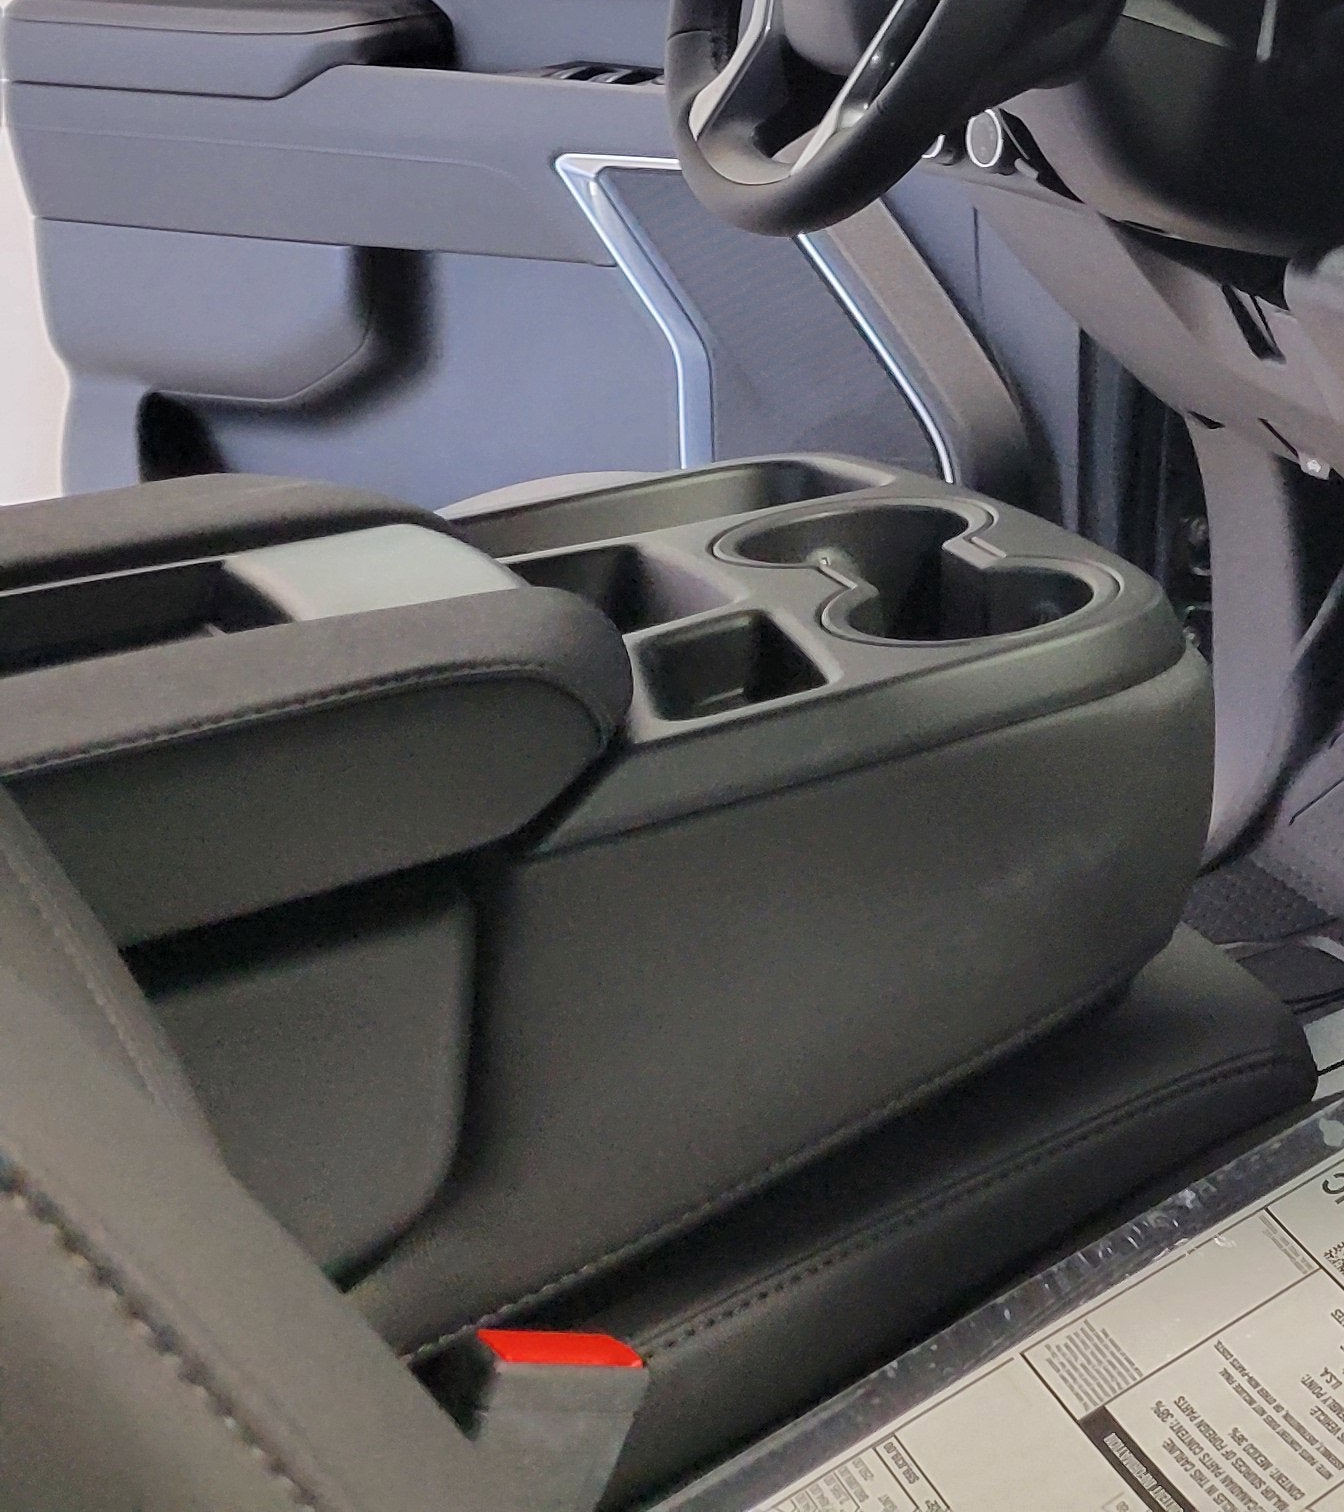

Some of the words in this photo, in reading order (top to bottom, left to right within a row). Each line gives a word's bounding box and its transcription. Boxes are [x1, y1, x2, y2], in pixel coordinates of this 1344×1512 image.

[1298, 1373, 1328, 1398] POINT:
[1316, 1366, 1344, 1389] U.S.A.
[1171, 1394, 1201, 1422] PARTS
[1306, 1405, 1343, 1435] VEHICLE:
[1166, 1418, 1205, 1455] CONTENT:
[1192, 1418, 1229, 1451] FOREIGN
[1159, 1437, 1197, 1472] CARLINE:
[1196, 1451, 1226, 1477] PARTS
[1221, 1447, 1238, 1460] OF
[1241, 1441, 1275, 1470] MEXICO
[1188, 1468, 1211, 1488] THIS
[1230, 1456, 1267, 1489] SOURCES
[1267, 1467, 1306, 1501] CONTENT:
[1203, 1484, 1219, 1495] IN
[1259, 1485, 1290, 1511] MAJOR
